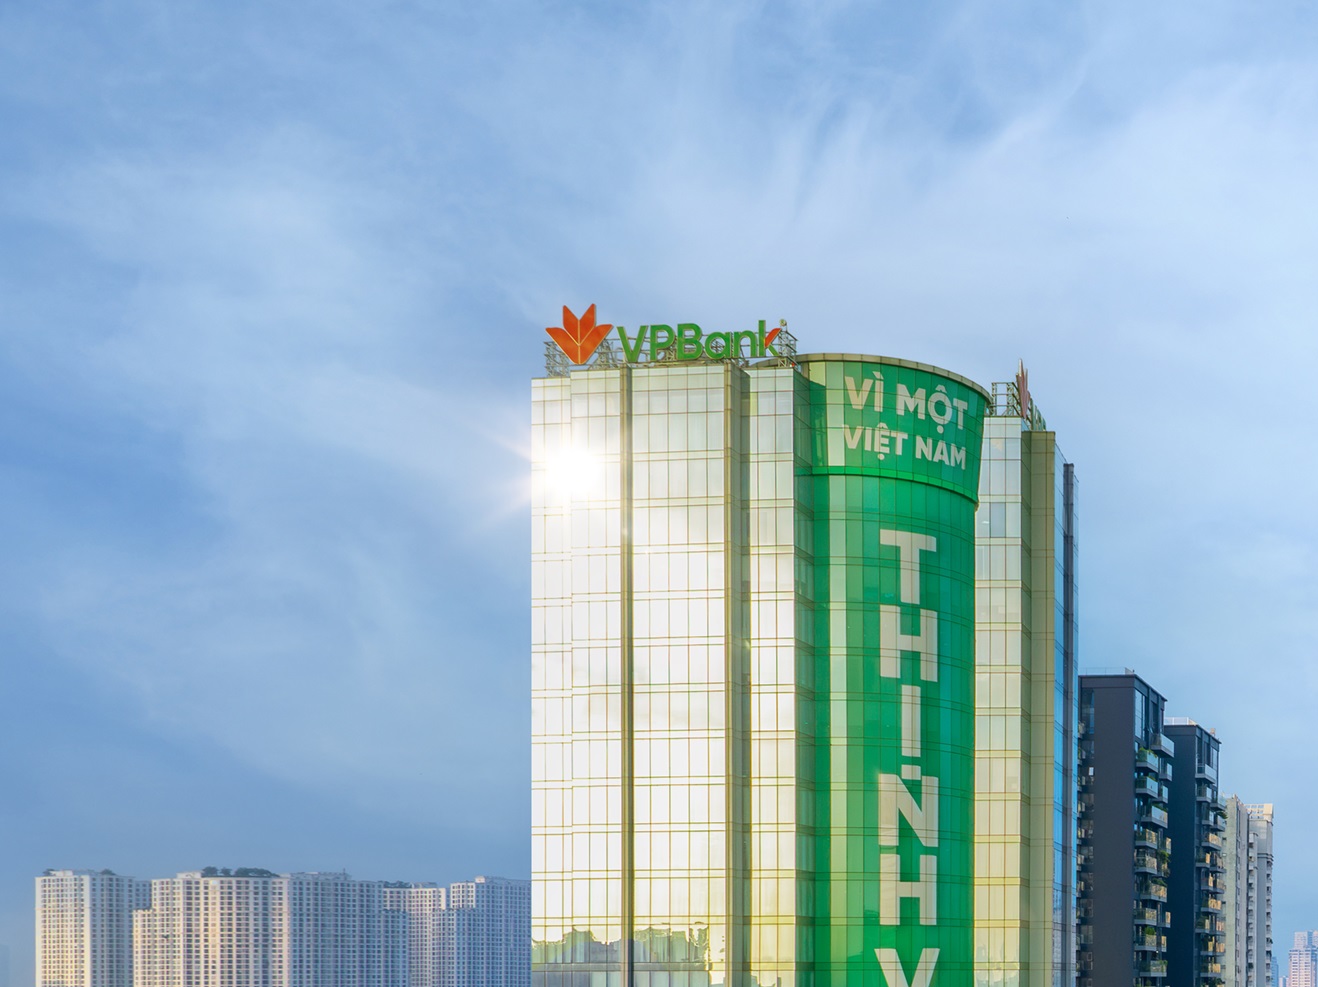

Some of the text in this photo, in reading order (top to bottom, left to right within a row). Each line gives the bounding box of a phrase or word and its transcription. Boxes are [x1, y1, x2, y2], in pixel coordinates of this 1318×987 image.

[616, 320, 781, 362] VPBank
[844, 371, 969, 434] VÌ MỘT
[843, 424, 967, 471] VIỆT NAM
[879, 529, 939, 925] THỊNH
